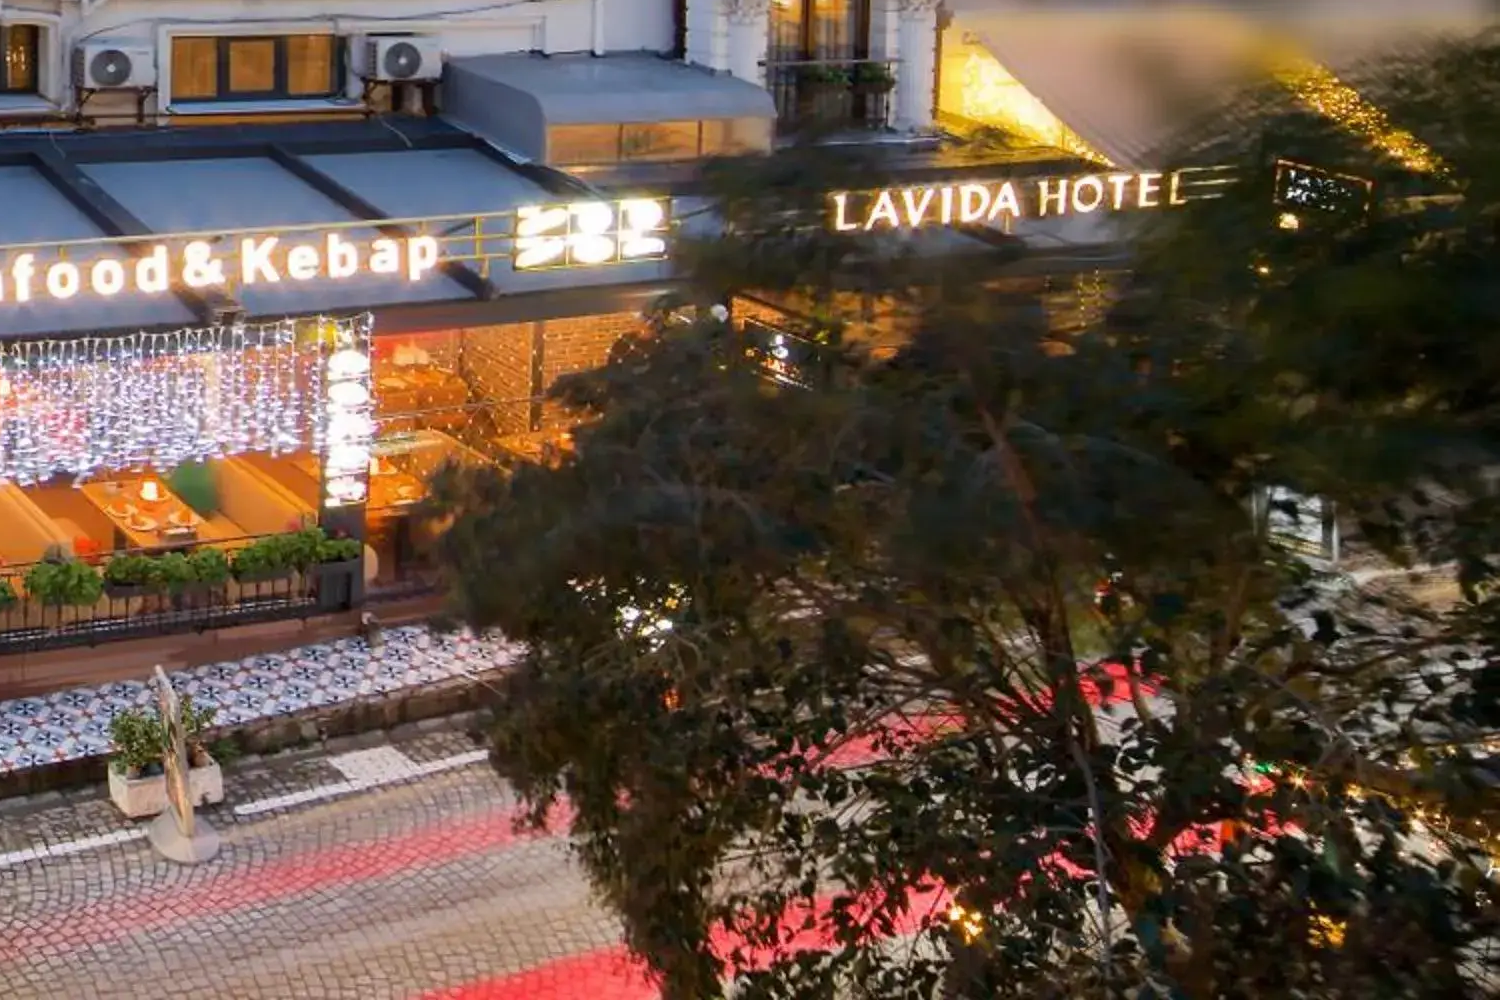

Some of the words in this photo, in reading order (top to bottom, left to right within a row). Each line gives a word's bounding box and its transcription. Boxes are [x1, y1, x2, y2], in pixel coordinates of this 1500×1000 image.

[833, 181, 1021, 231] LAVIDA
[1038, 172, 1187, 217] HOTEL
[242, 233, 438, 281] Kebap
